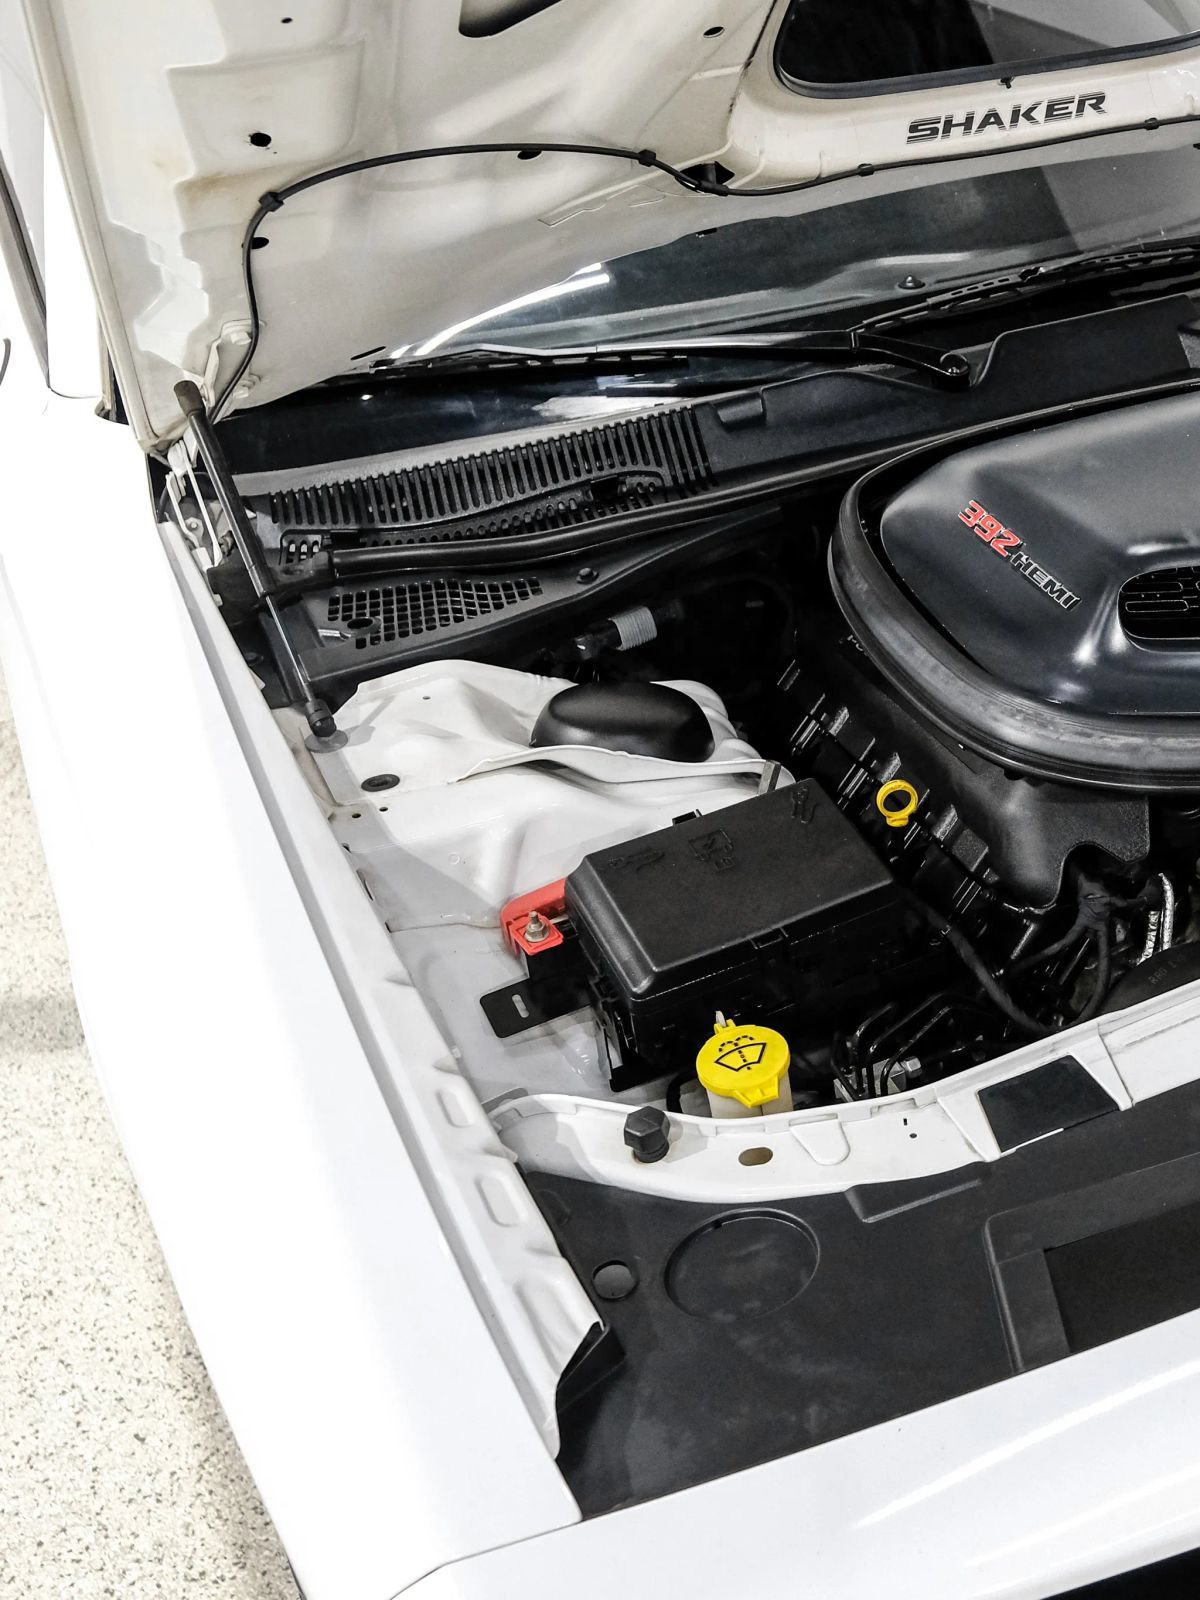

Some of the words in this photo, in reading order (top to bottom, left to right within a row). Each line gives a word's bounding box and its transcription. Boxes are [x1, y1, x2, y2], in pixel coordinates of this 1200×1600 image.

[906, 91, 1107, 144] SHAKER
[958, 500, 1022, 557] 392
[1010, 551, 1081, 609] HEMI
